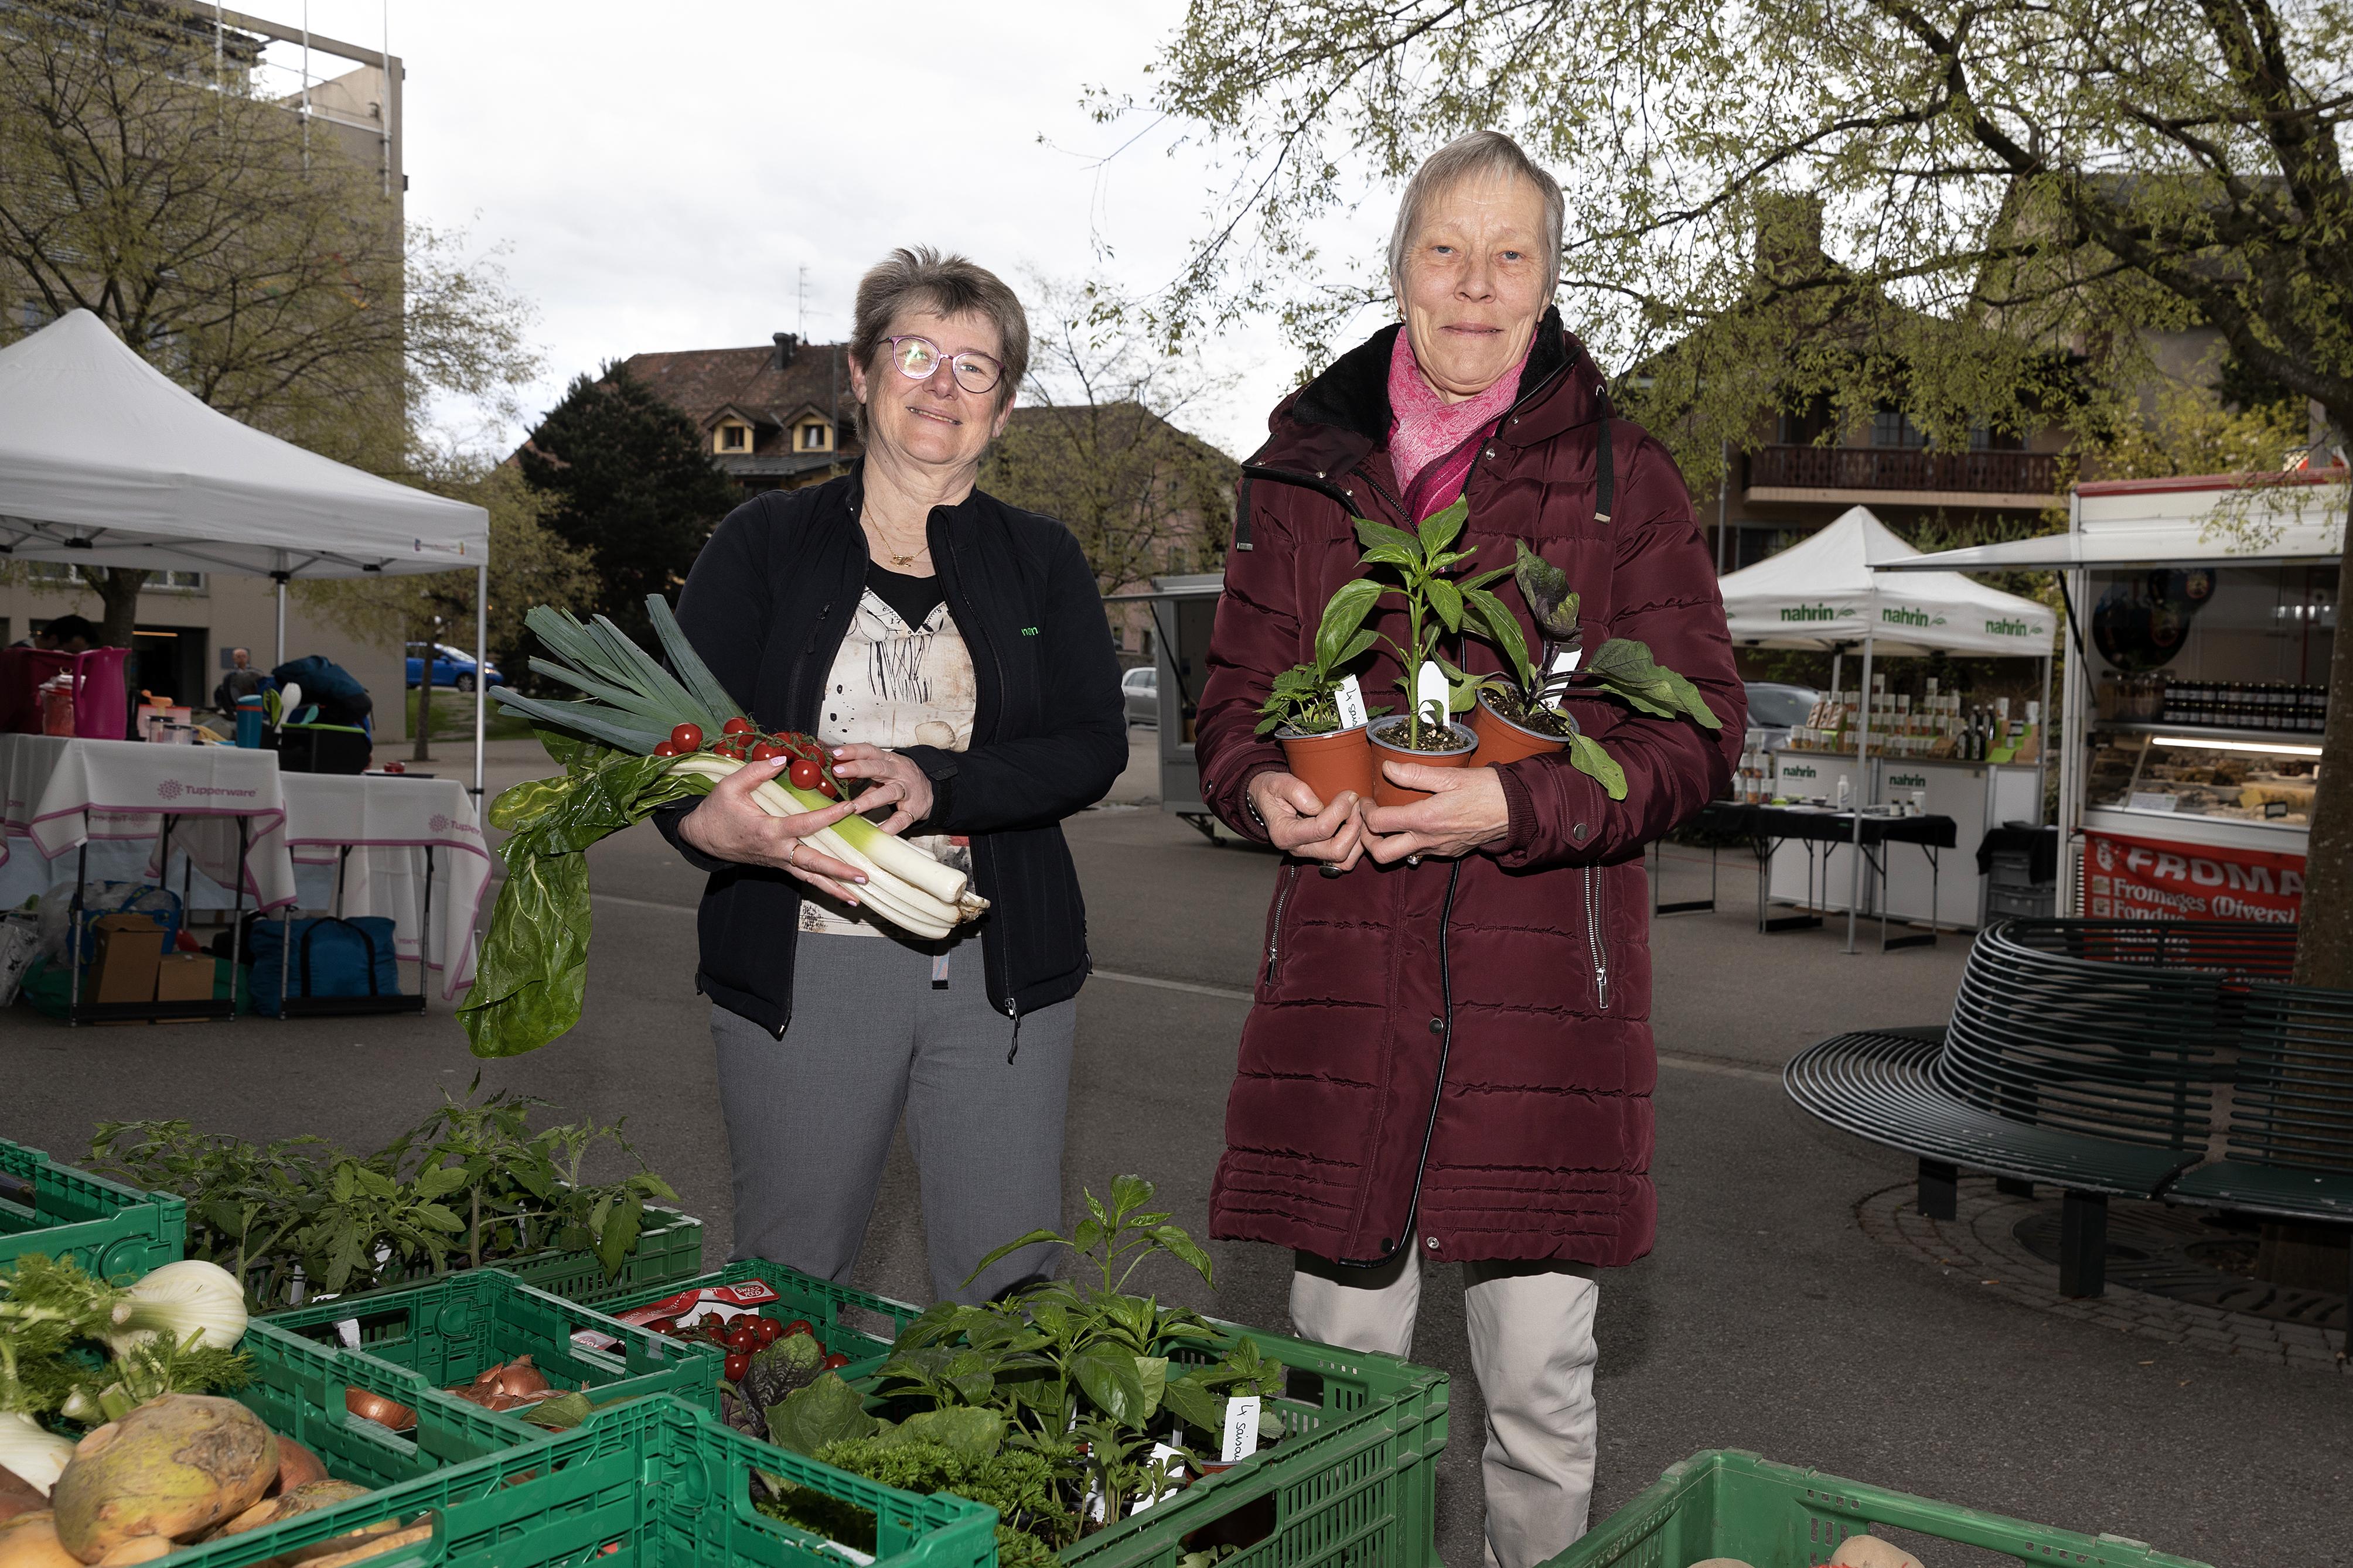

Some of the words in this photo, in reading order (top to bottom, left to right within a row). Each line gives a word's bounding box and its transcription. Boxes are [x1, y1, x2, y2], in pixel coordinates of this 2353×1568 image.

[1781, 603, 1834, 621] nahrin
[1882, 606, 1929, 627] nahrin
[1985, 617, 2027, 637] nahrin
[1783, 766, 1816, 778] nahrin
[1889, 773, 1926, 787] nahrin
[186, 785, 257, 797] Tupperware
[2113, 877, 2207, 913] Fromages
[2211, 895, 2296, 924] (Divers)
[1237, 1405, 1254, 1416] 4
